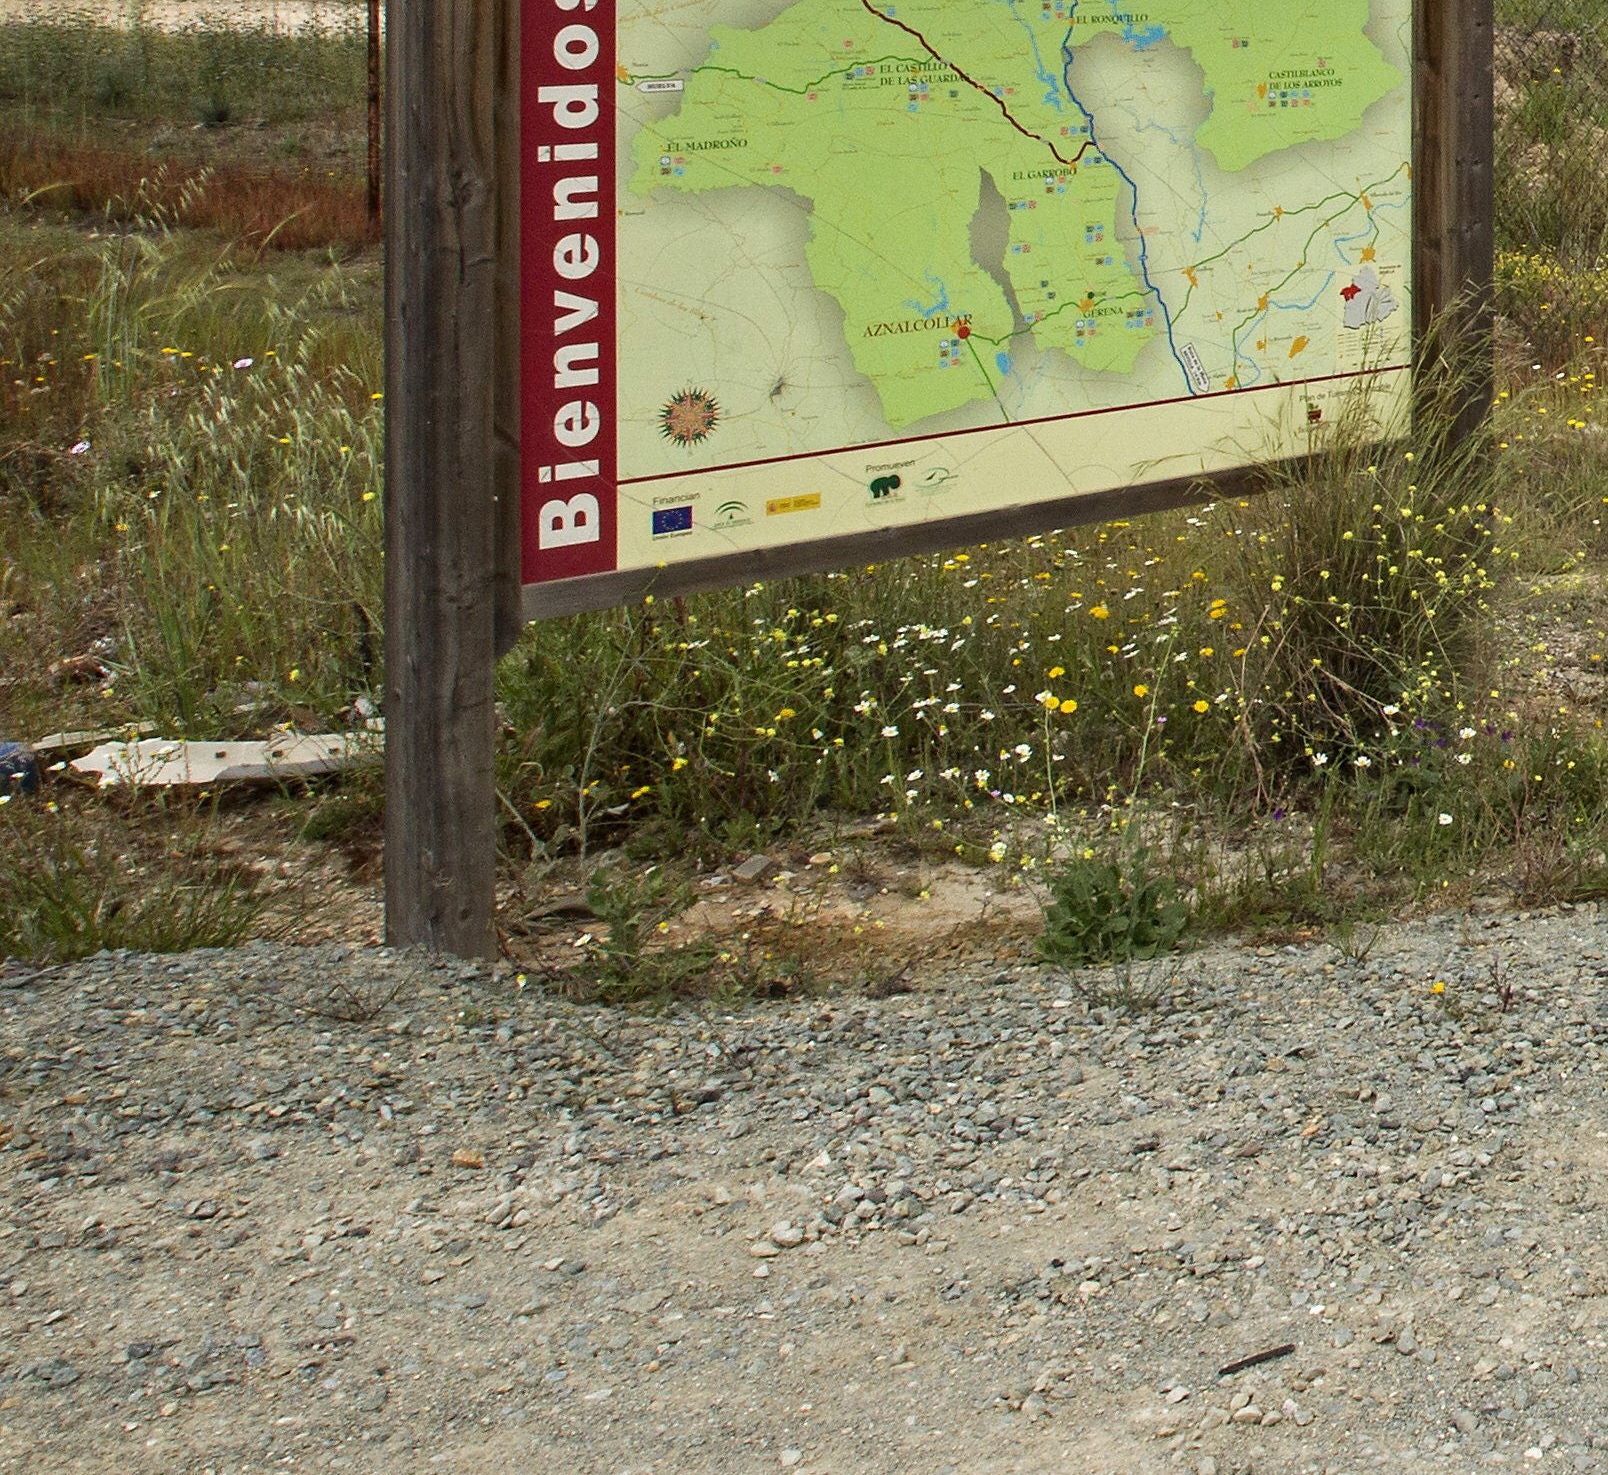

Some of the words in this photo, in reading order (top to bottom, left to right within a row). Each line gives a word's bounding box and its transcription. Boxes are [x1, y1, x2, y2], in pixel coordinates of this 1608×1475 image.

[1076, 16, 1087, 24] EL
[1091, 13, 1148, 25] RONQUILLO
[880, 65, 892, 73] EL
[896, 62, 948, 73] CASTILLO
[1268, 68, 1335, 80] CASTILBLANCO
[880, 77, 894, 86] DE
[898, 76, 919, 84] LAS
[1269, 82, 1280, 90] DE
[1284, 81, 1300, 89] LOS
[1303, 78, 1343, 88] ARROYOS
[666, 141, 680, 152] EL
[686, 137, 748, 151] MADROÑO
[1012, 171, 1024, 181] EL
[1027, 167, 1078, 180] GARROBO
[1082, 307, 1124, 319] GERENA
[866, 460, 916, 473] Promueven
